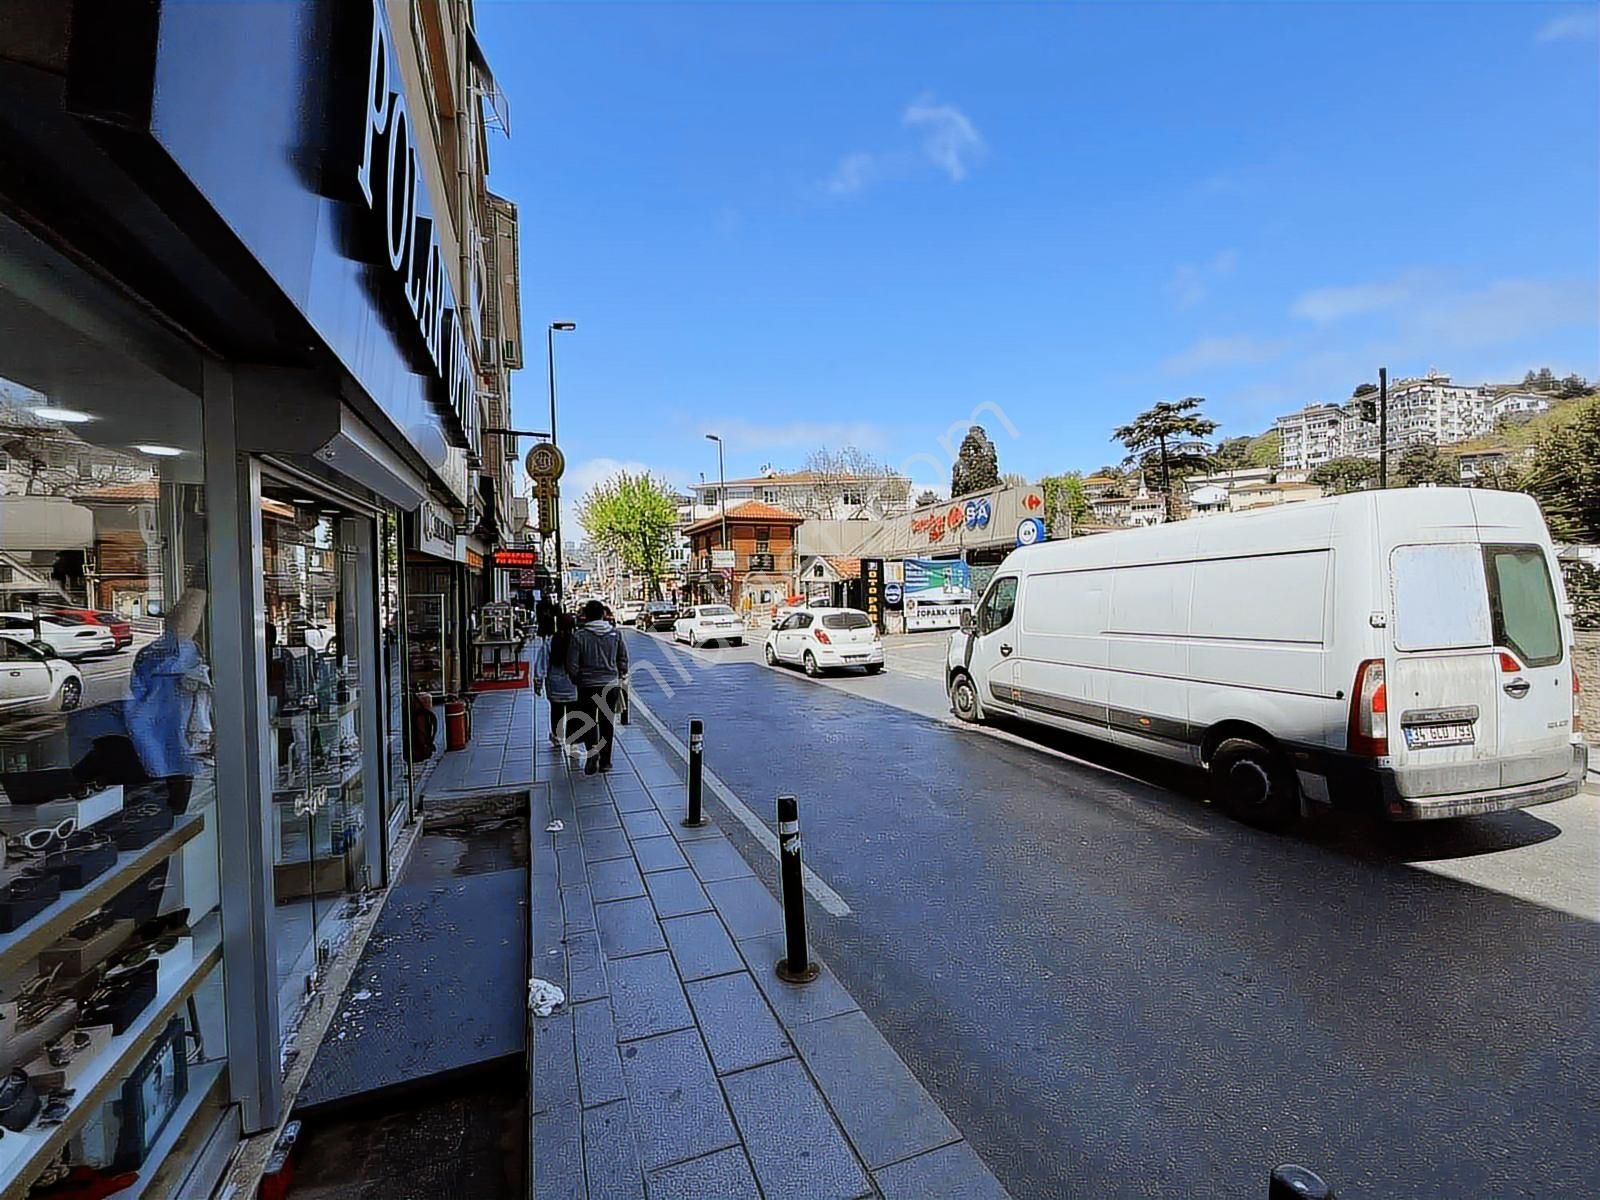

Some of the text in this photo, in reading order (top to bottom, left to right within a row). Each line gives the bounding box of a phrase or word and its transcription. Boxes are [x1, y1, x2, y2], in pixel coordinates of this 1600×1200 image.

[358, 0, 443, 378] POLAR
[867, 571, 878, 622] OTOPAR
[917, 608, 947, 617] TOPARK
